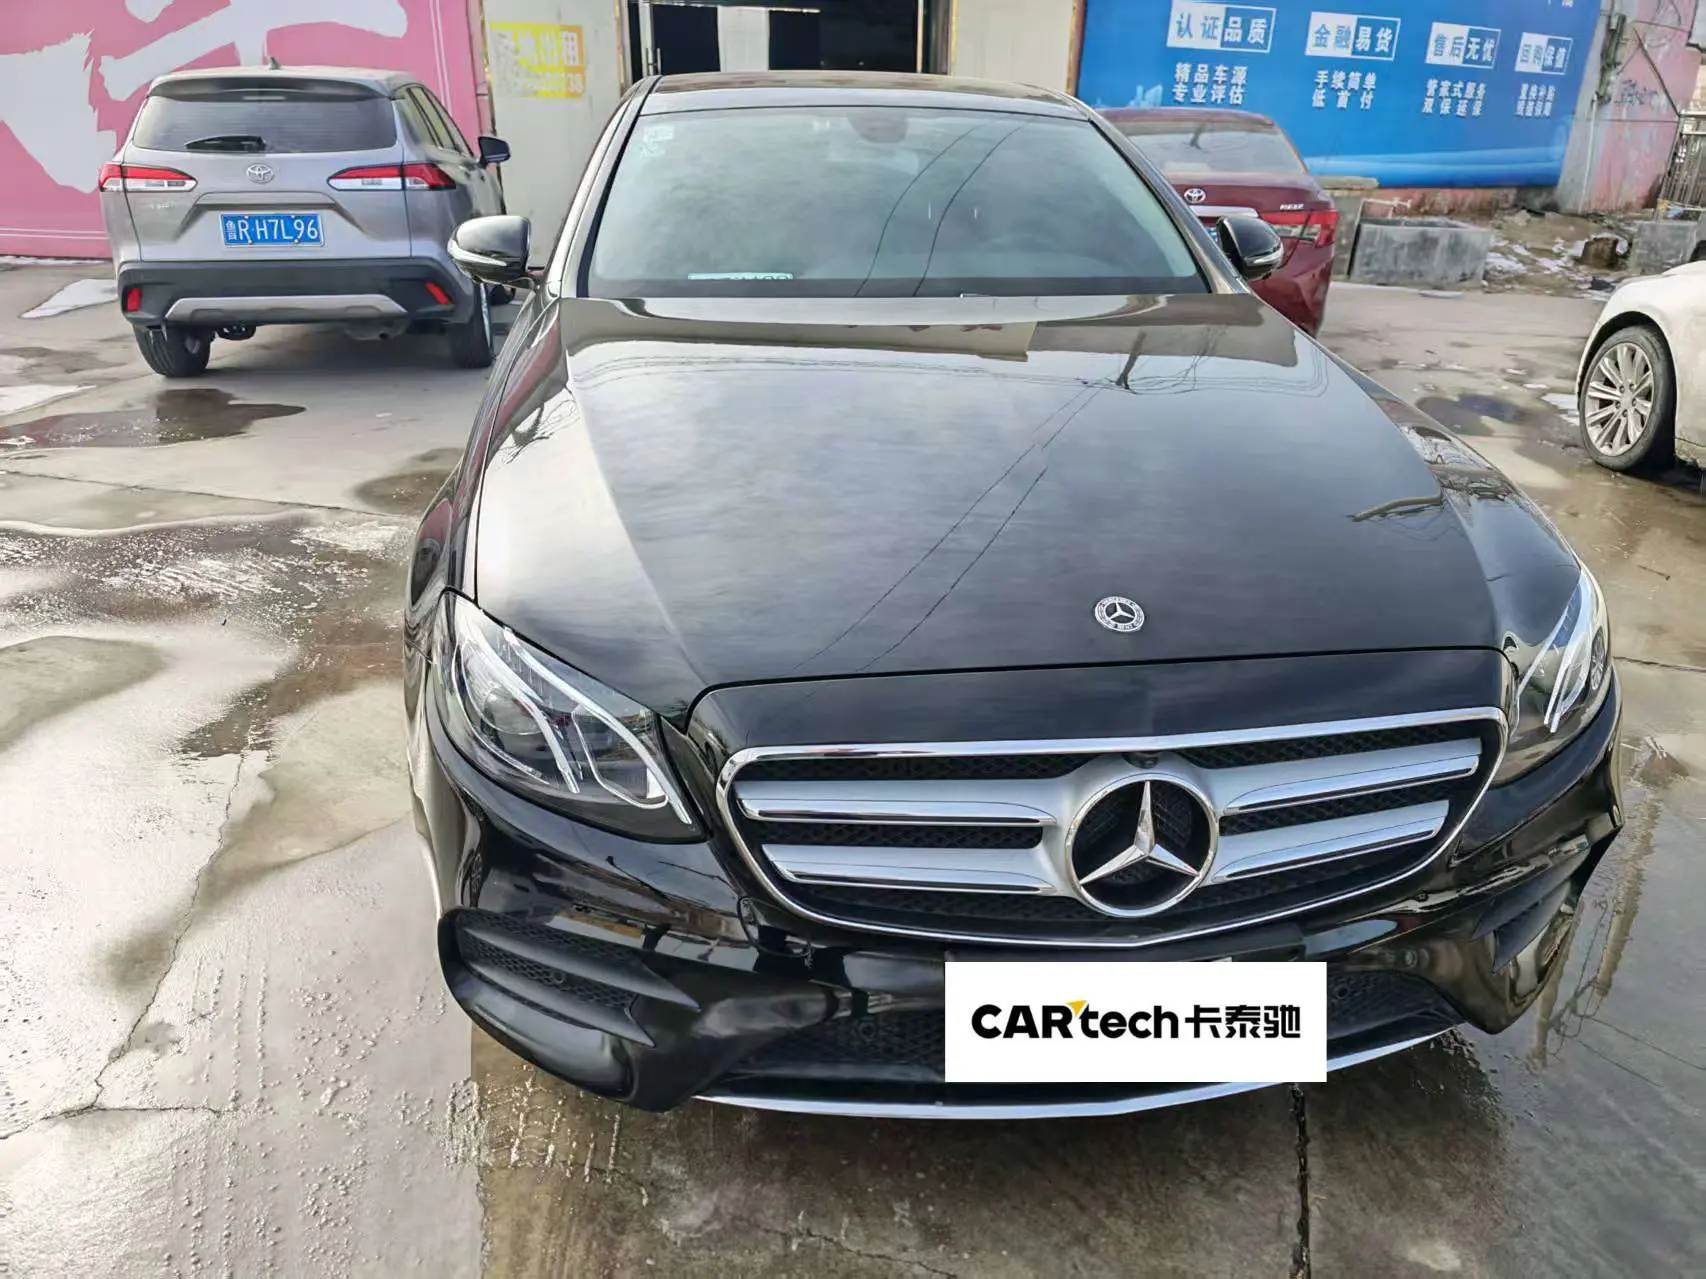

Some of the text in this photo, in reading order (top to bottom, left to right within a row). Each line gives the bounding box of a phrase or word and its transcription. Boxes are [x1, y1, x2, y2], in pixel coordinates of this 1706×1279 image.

[1175, 11, 1267, 45] 认证品质
[1433, 33, 1495, 62] 售后无忧
[1174, 62, 1248, 84] 精品车源
[1313, 69, 1377, 90] 手续简单
[1172, 82, 1245, 105] 专业评估
[1311, 88, 1374, 110] 低首付
